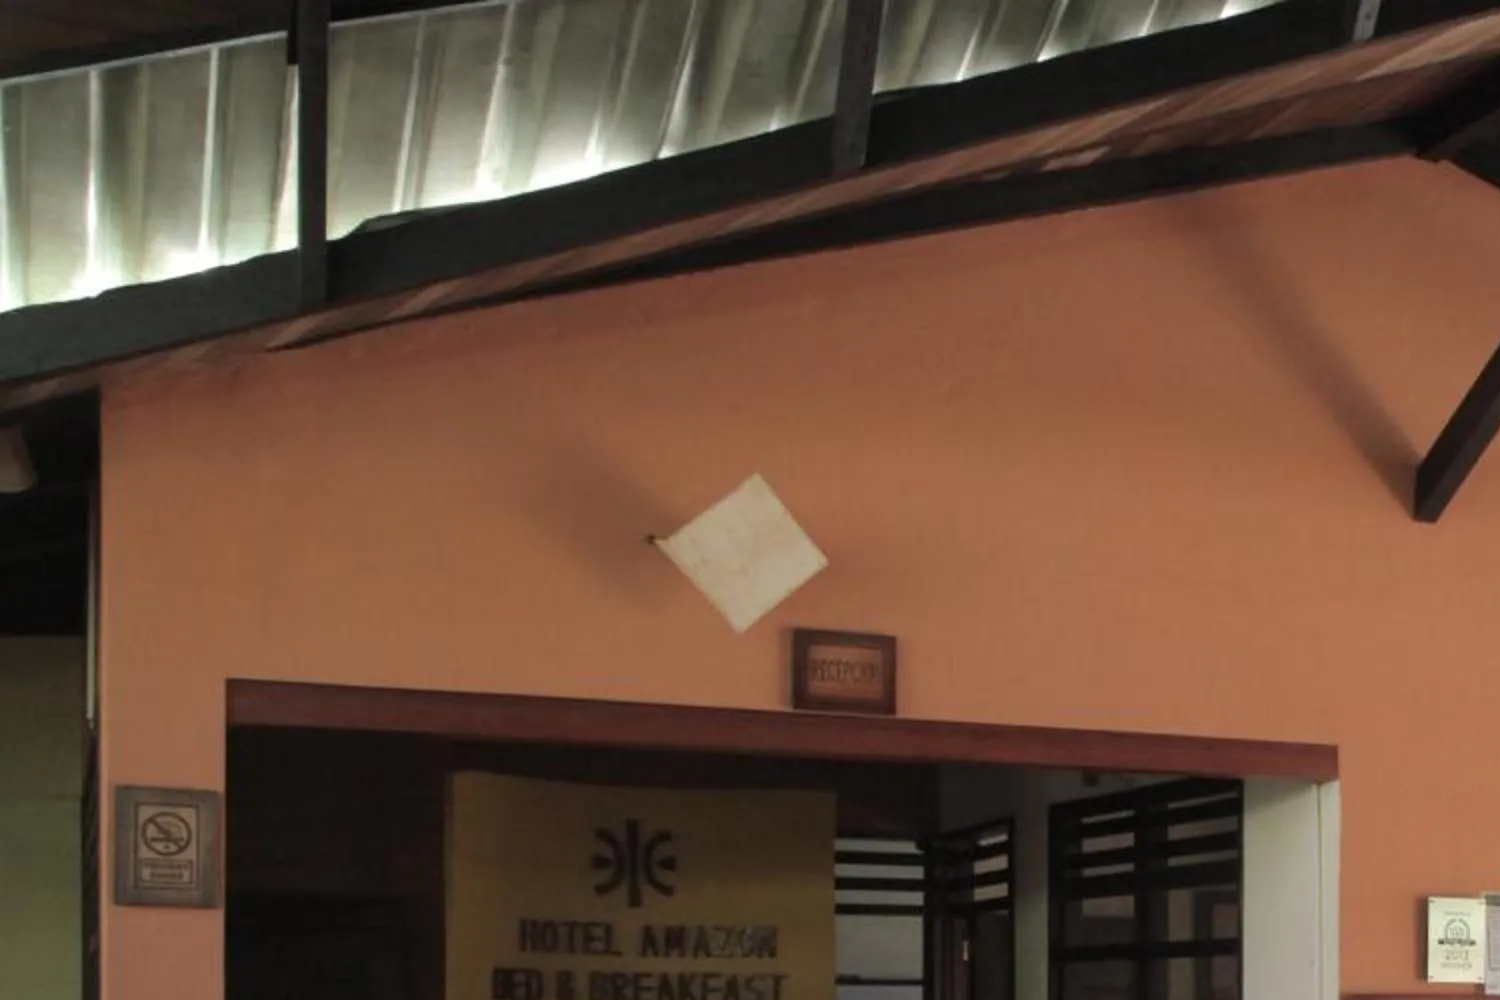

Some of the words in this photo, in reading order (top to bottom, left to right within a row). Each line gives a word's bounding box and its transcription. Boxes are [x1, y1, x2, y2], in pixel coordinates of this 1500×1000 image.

[519, 919, 622, 956] HOTEL
[639, 924, 778, 959] AMAZON
[492, 966, 543, 1000] BED
